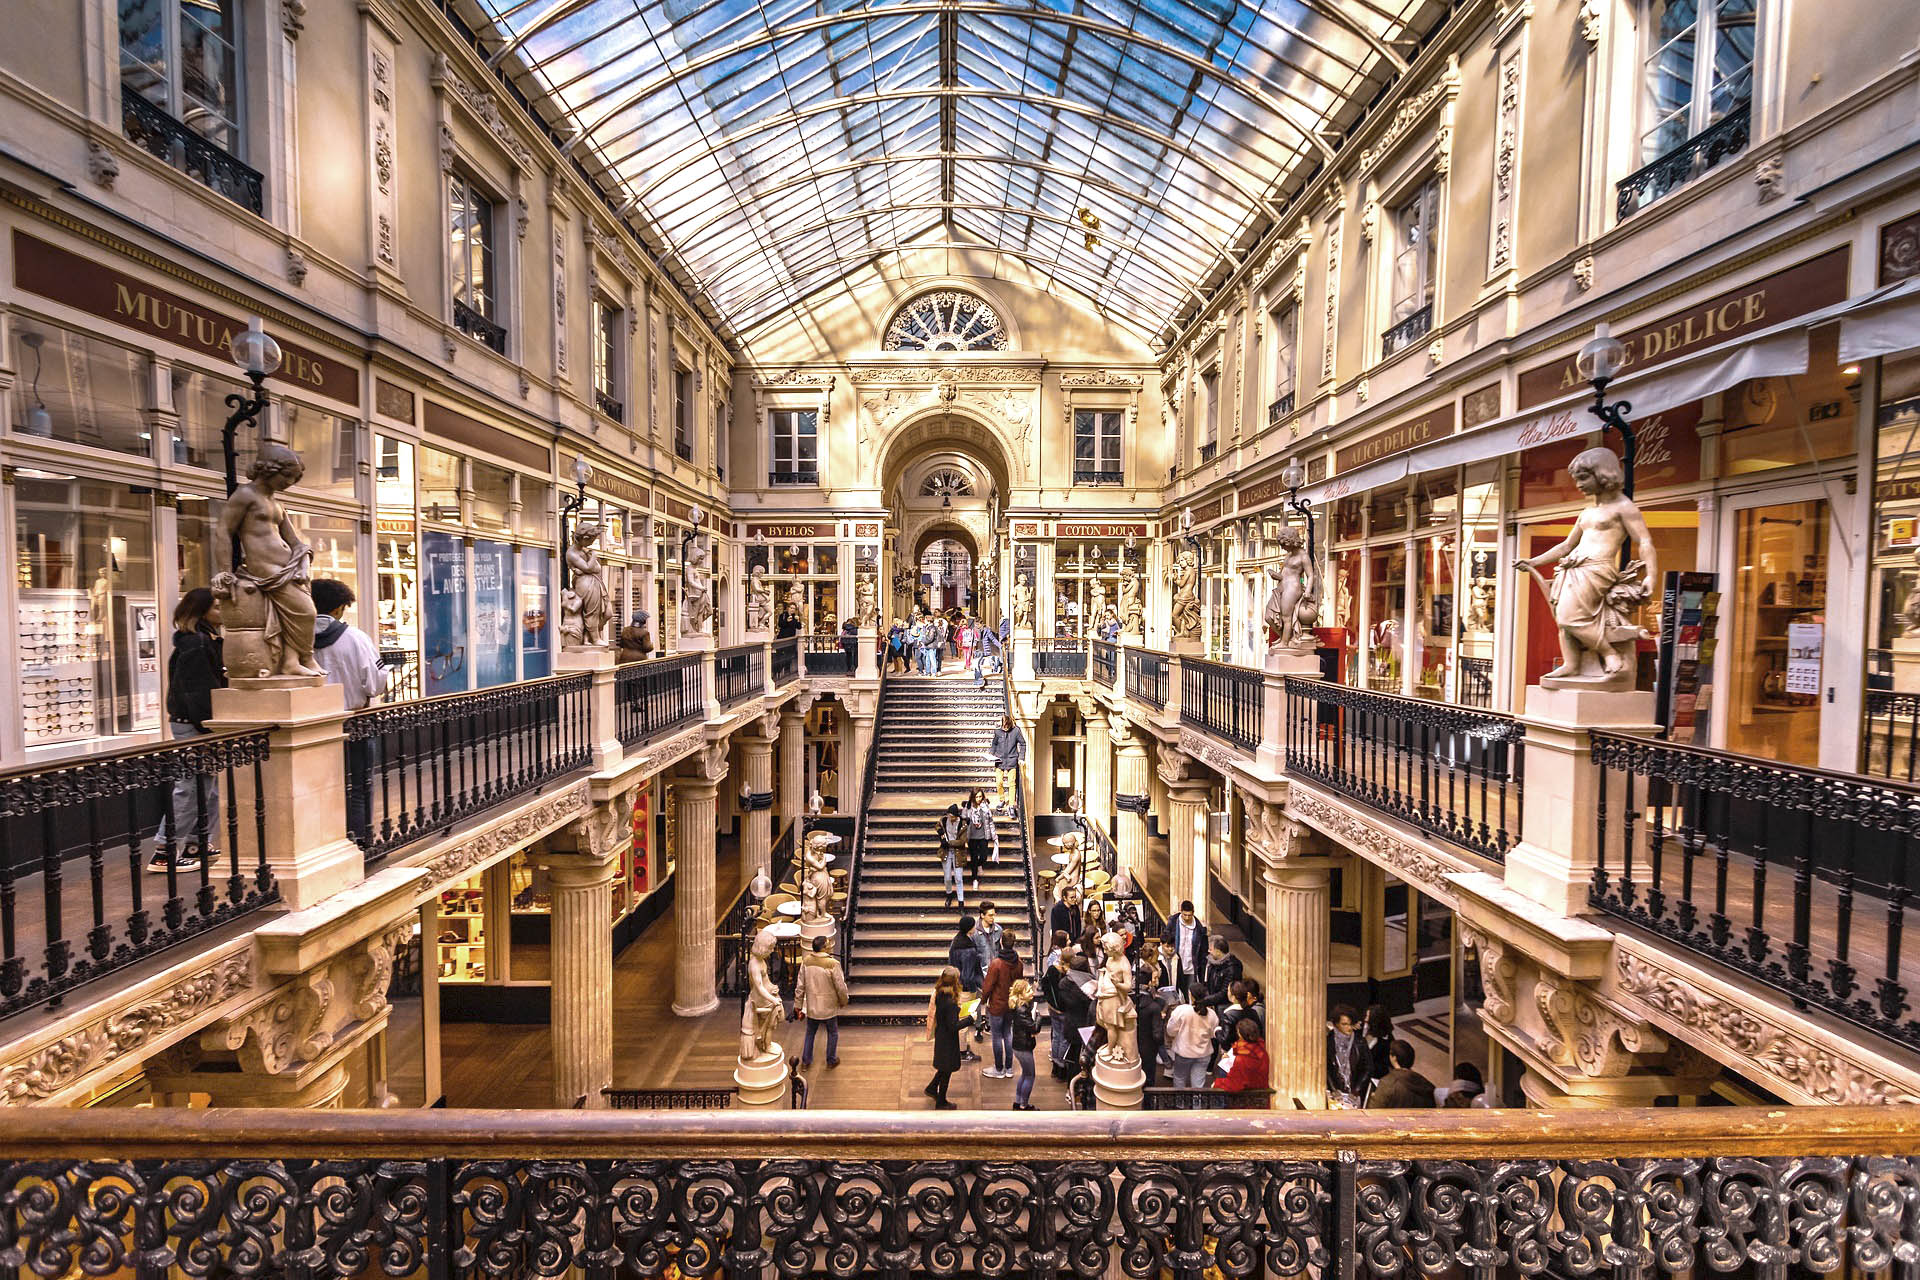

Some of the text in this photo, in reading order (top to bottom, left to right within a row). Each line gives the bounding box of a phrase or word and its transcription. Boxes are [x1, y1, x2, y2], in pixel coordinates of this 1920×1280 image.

[113, 282, 324, 386] MUTUATES
[1641, 290, 1766, 361] DELICE
[1517, 411, 1578, 448] Alice Délice
[1351, 420, 1431, 465] ALICE DELICE
[1242, 493, 1250, 506] LA
[768, 526, 815, 537] BYBLOS
[1065, 525, 1139, 536] COTON DOUX
[451, 564, 496, 577] DES CRANS
[443, 577, 465, 594] AVEC
